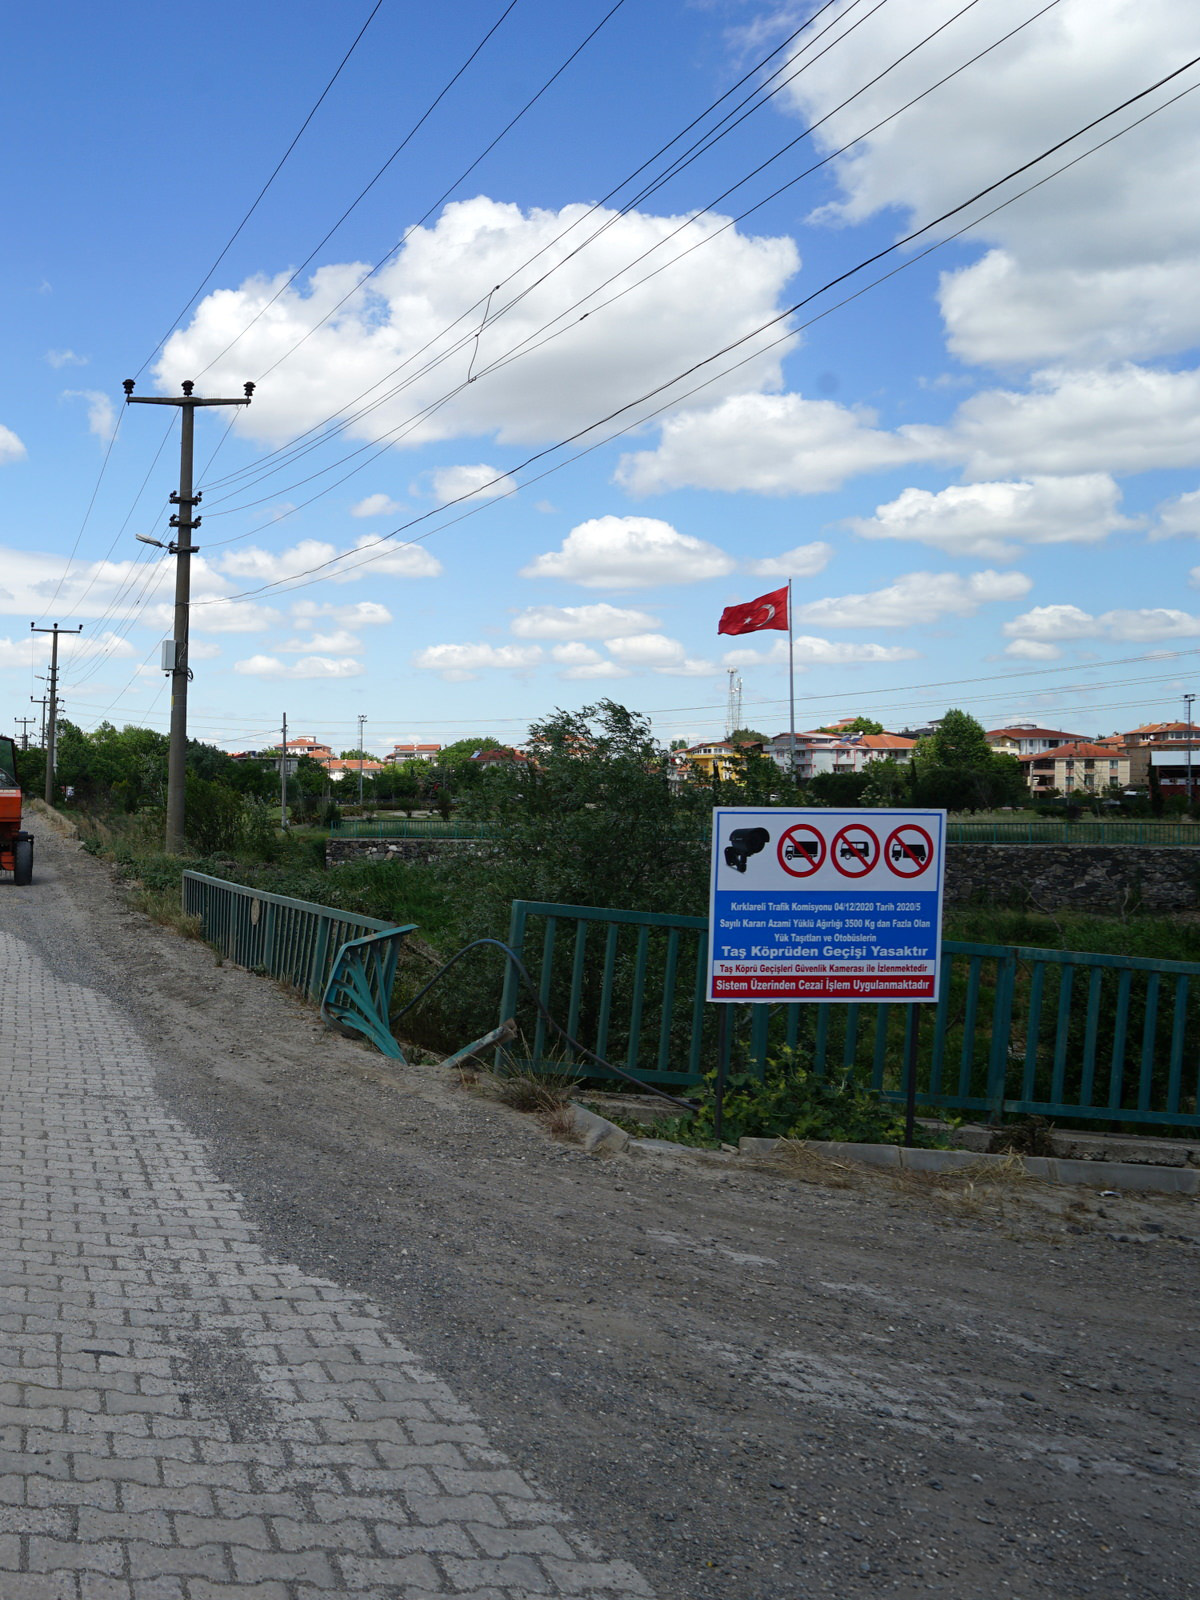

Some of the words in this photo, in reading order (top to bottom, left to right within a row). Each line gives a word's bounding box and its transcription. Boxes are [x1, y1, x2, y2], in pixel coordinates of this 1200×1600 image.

[731, 902, 766, 911] Kırklareli
[768, 902, 789, 911] Trafik
[792, 902, 832, 913] Komisyonu
[834, 902, 874, 911] 04/12/2020
[876, 902, 894, 911] Tarih
[897, 902, 921, 911] 2020/5
[720, 919, 740, 930] Sayılı
[768, 919, 791, 928] Azami
[793, 918, 814, 928] Yüklü
[816, 919, 843, 930] Ağırlığı
[844, 919, 863, 928] 3500
[865, 919, 875, 930] Kg
[877, 919, 890, 928] dan
[892, 919, 911, 928] Fazla
[914, 919, 930, 928] Olan
[774, 933, 789, 942] Yük
[791, 933, 821, 944] Taşıtları
[834, 933, 876, 942] Otobüslerin
[721, 946, 746, 959] Taş
[751, 946, 818, 959] Köprüden
[823, 946, 866, 959] Geçişi
[871, 946, 928, 957] Yasaktır
[720, 965, 733, 974] Taş
[736, 964, 757, 974] Köprü
[760, 964, 792, 974] Geçişleri
[795, 964, 826, 973] Güvenlik
[829, 964, 864, 973] Kamerası
[867, 964, 875, 973] ile
[878, 963, 927, 973] İzlenmektedir
[716, 980, 748, 990] Sistem
[750, 978, 796, 990] Üzerinden
[798, 980, 823, 990] Cezai
[826, 978, 850, 992] İşlem
[853, 980, 929, 992] Uygulanmaktadır
